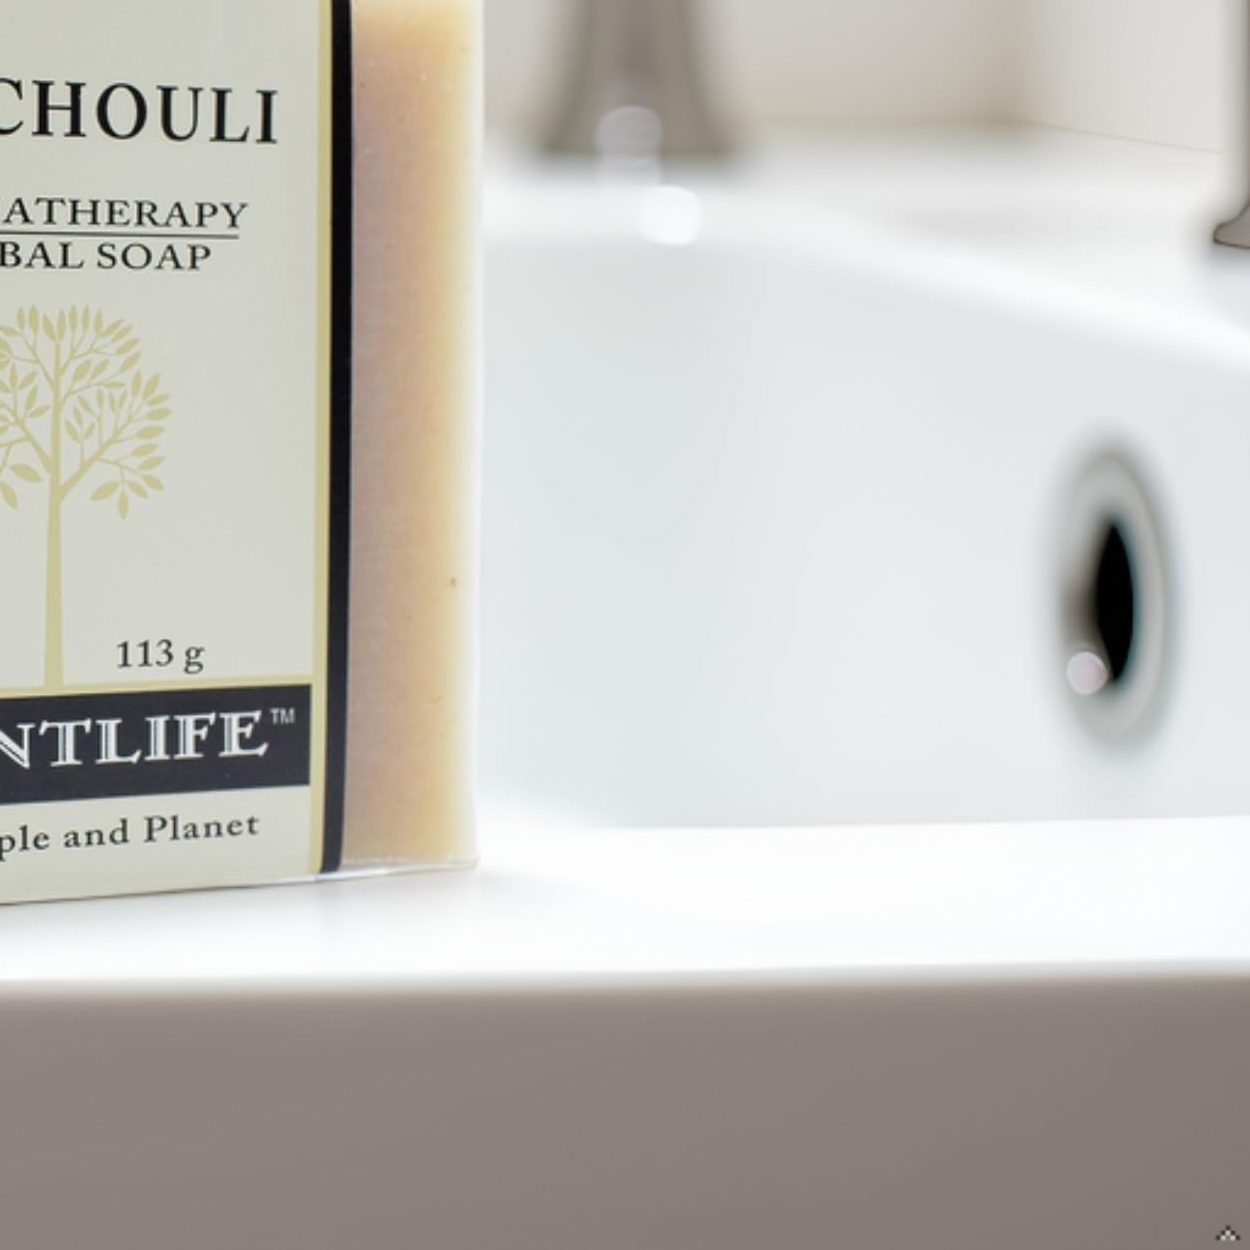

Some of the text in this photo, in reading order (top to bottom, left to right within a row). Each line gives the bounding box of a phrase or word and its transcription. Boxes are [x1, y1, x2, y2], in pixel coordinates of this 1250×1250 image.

[97, 243, 212, 271] SOAP
[116, 638, 206, 674] 113 g
[63, 817, 130, 849] and
[144, 814, 260, 844] Planet
